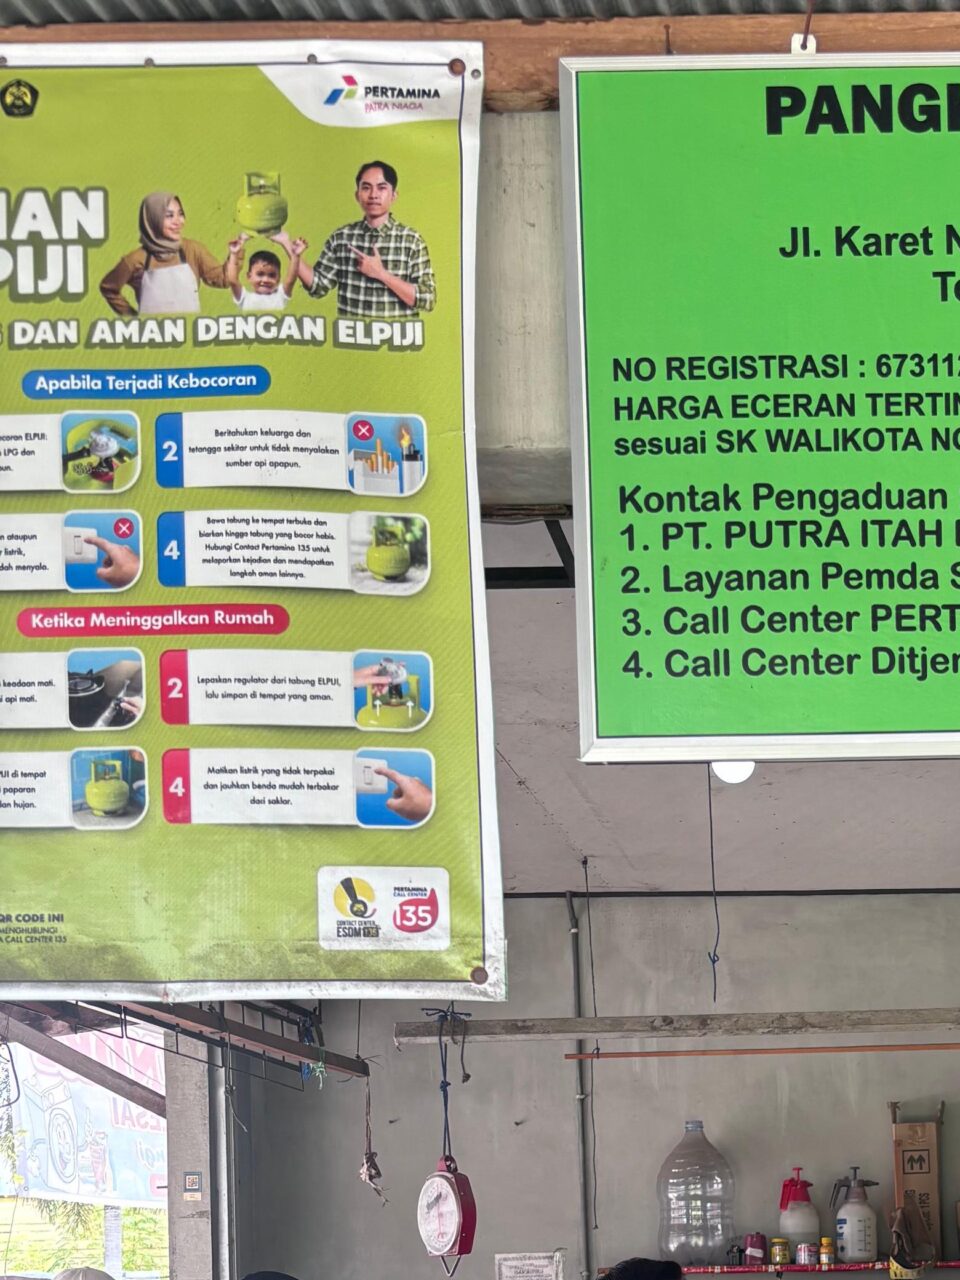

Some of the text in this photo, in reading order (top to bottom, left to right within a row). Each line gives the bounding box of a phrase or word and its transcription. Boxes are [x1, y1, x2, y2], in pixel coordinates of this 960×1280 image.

[364, 85, 441, 100] PERTAMINA
[365, 101, 424, 114] PATRA NIAGA
[778, 226, 821, 258] Jl.
[834, 224, 933, 257] Karet
[13, 315, 424, 347] DAN AMAN DENGAN ELPIJI
[612, 357, 656, 382] NO
[665, 354, 848, 381] REGISTRASI
[35, 373, 257, 395] Apabila Terjadi Kebocoran
[614, 395, 723, 421] HARGA
[731, 392, 855, 419] ECERAN
[214, 427, 312, 439] Beritahukan keluarga dan
[614, 431, 706, 456] sesuai
[715, 429, 757, 454] SK
[766, 427, 923, 453] WALIKOTA
[162, 440, 179, 461] 2
[619, 481, 948, 517] Kontak Pengaduan
[619, 523, 650, 552] 1.
[662, 521, 712, 551] PT.
[724, 519, 850, 550] PUTRA
[860, 518, 943, 548] ITAH
[163, 540, 181, 561] 4
[620, 565, 651, 594] 2.
[663, 564, 810, 599] Layanan
[821, 561, 940, 591] Pemda
[31, 609, 274, 631] Ketika Meninggalkan Rumah
[621, 608, 652, 637] 3.
[663, 605, 729, 635] Call
[740, 604, 861, 634] Center
[622, 650, 653, 680] 4.
[664, 647, 730, 678] Call
[741, 646, 861, 677] Center
[166, 678, 183, 699] 2
[197, 675, 316, 687] Lepaskan regulator dari tabung
[169, 776, 186, 797] 4
[15, 913, 64, 923] CODE INI
[395, 905, 432, 927] 135
[4, 935, 54, 944] CALL CENTER
[336, 926, 362, 938] ESDM
